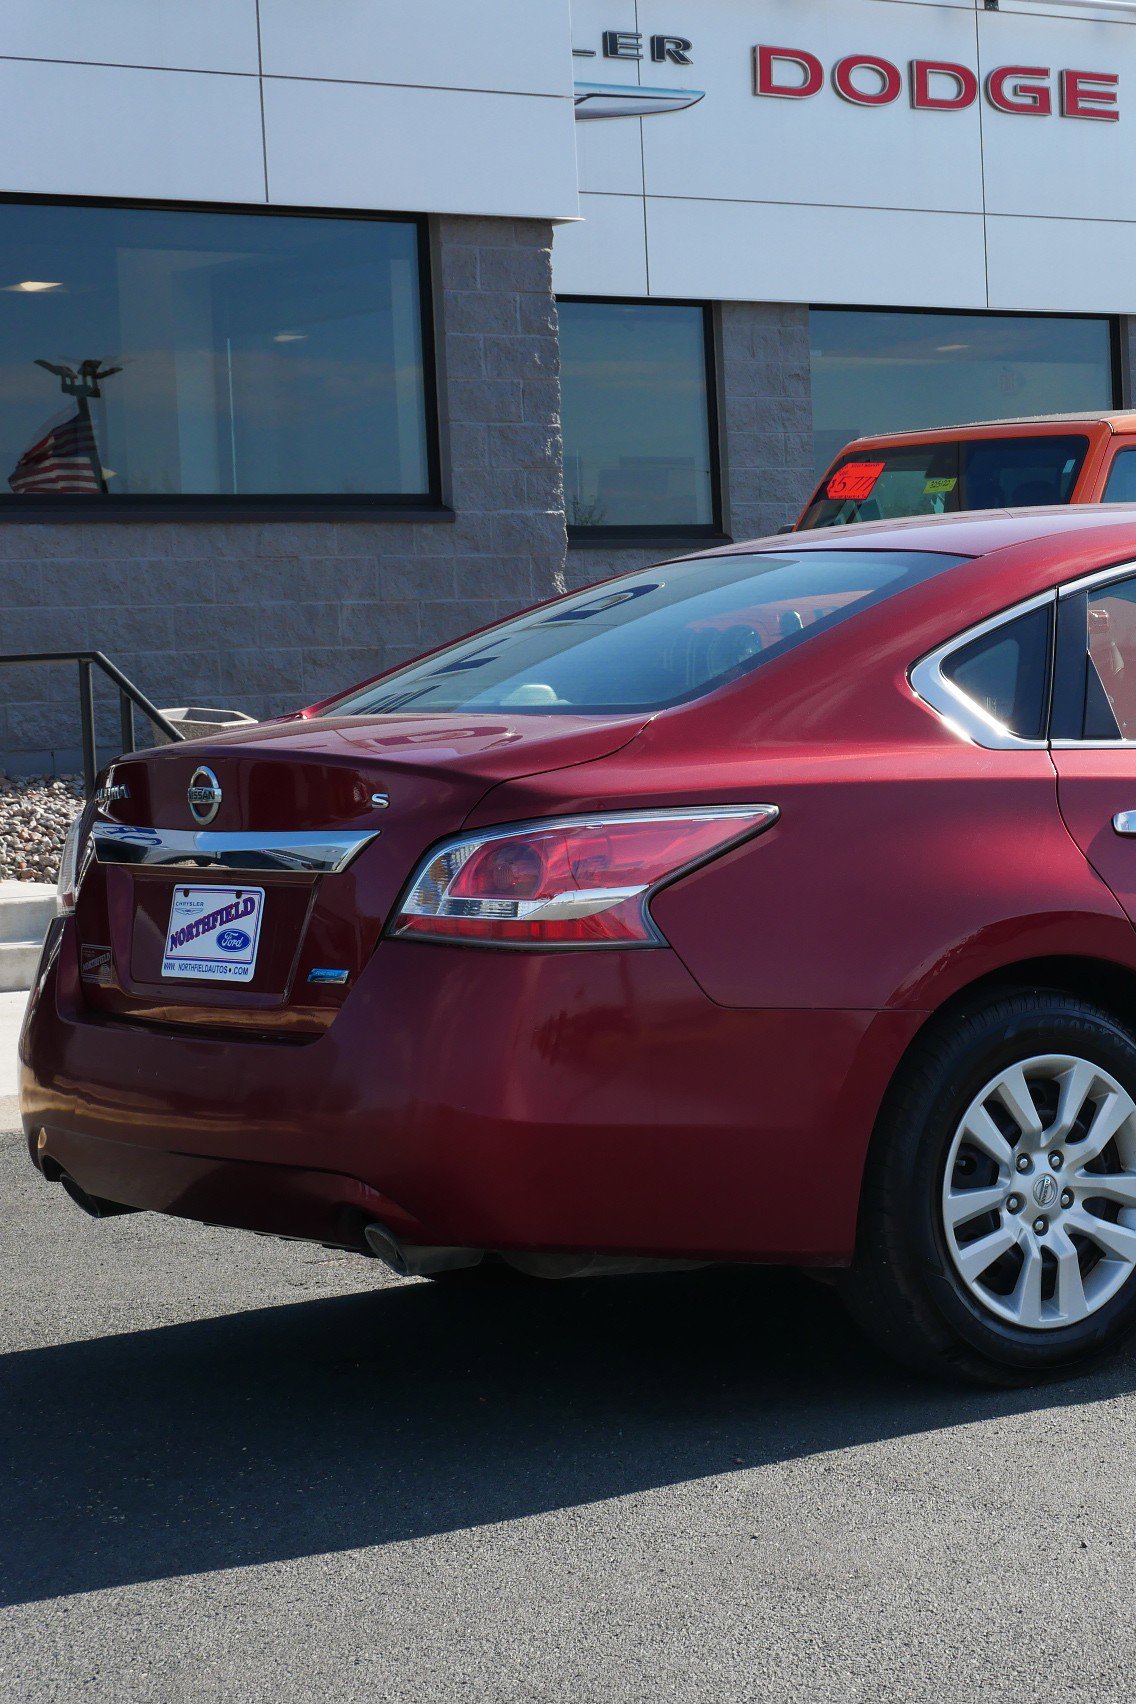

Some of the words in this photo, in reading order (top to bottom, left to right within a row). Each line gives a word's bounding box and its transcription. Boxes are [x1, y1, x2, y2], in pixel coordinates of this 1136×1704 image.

[753, 44, 1119, 121] DODGE
[371, 793, 389, 808] S
[169, 897, 255, 952] NORTHFIELD
[221, 931, 244, 948] Ford
